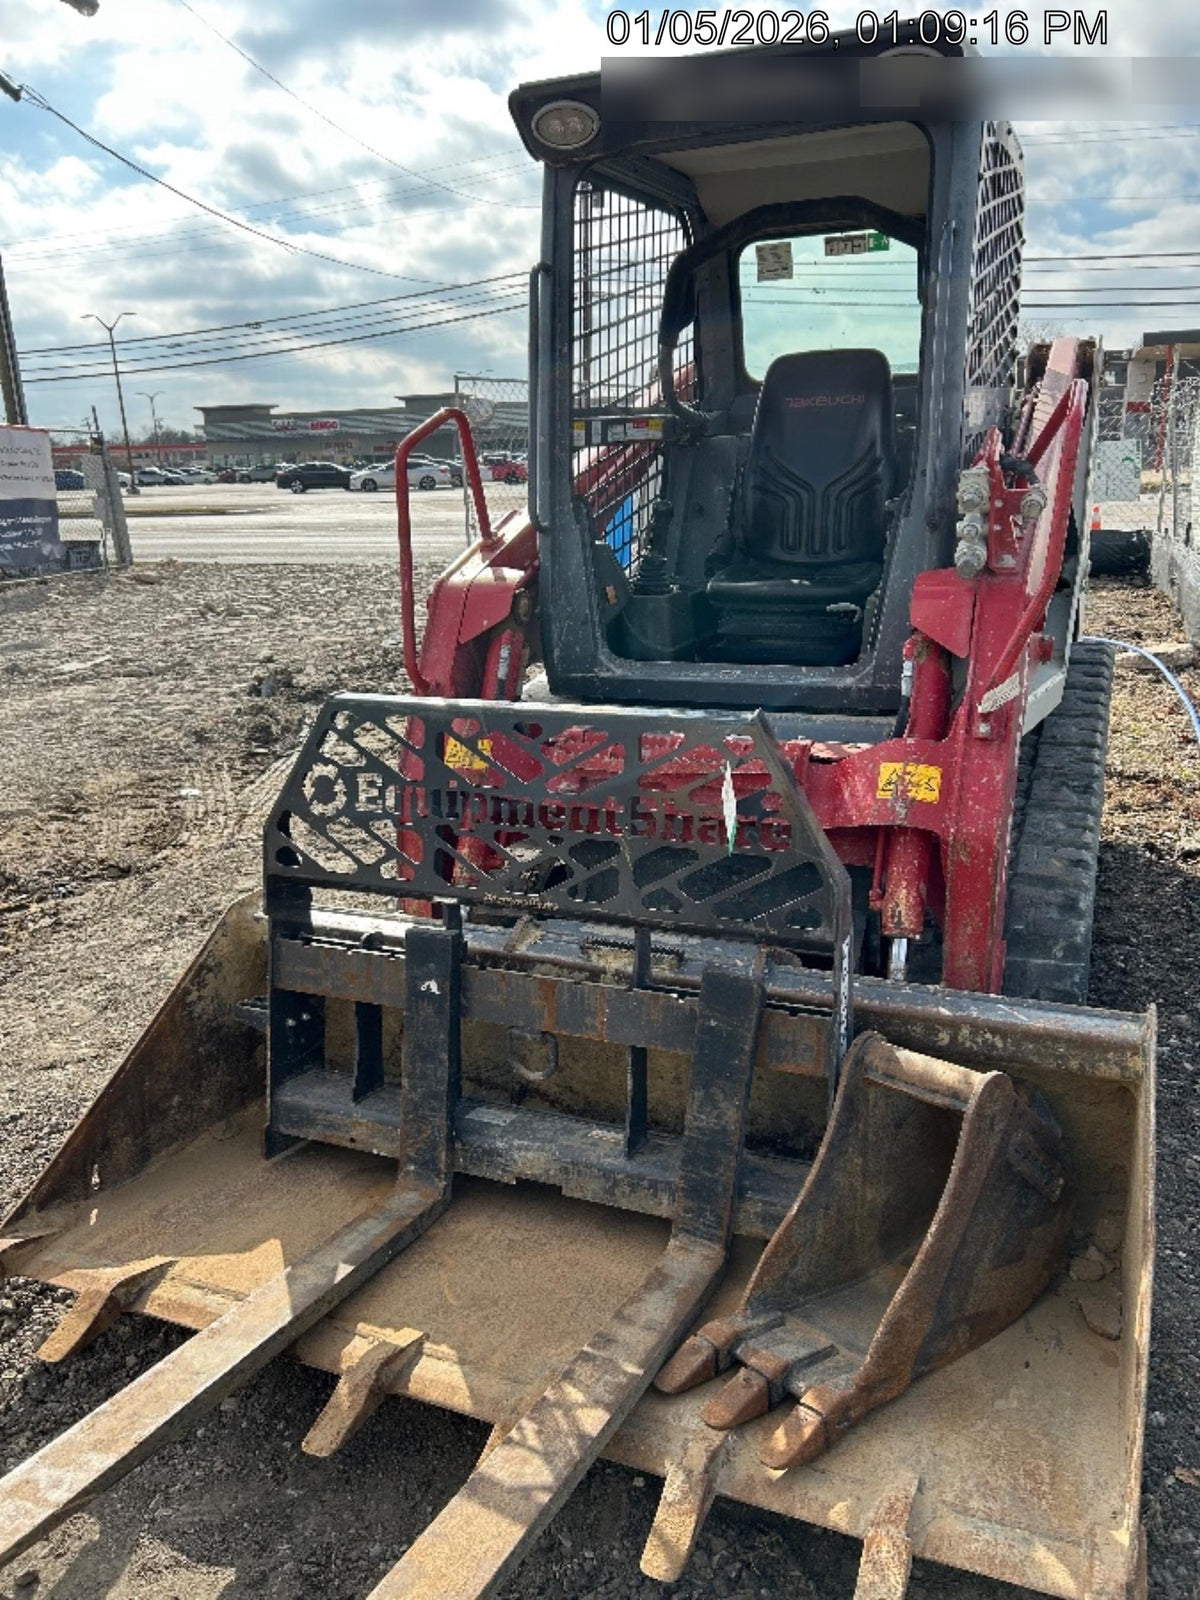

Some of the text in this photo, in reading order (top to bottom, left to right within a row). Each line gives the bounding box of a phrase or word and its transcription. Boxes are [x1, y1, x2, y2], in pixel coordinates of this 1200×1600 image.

[784, 392, 865, 408] TAKEUCHI
[310, 421, 338, 431] BINGO
[355, 772, 792, 852] EquipmentShare
